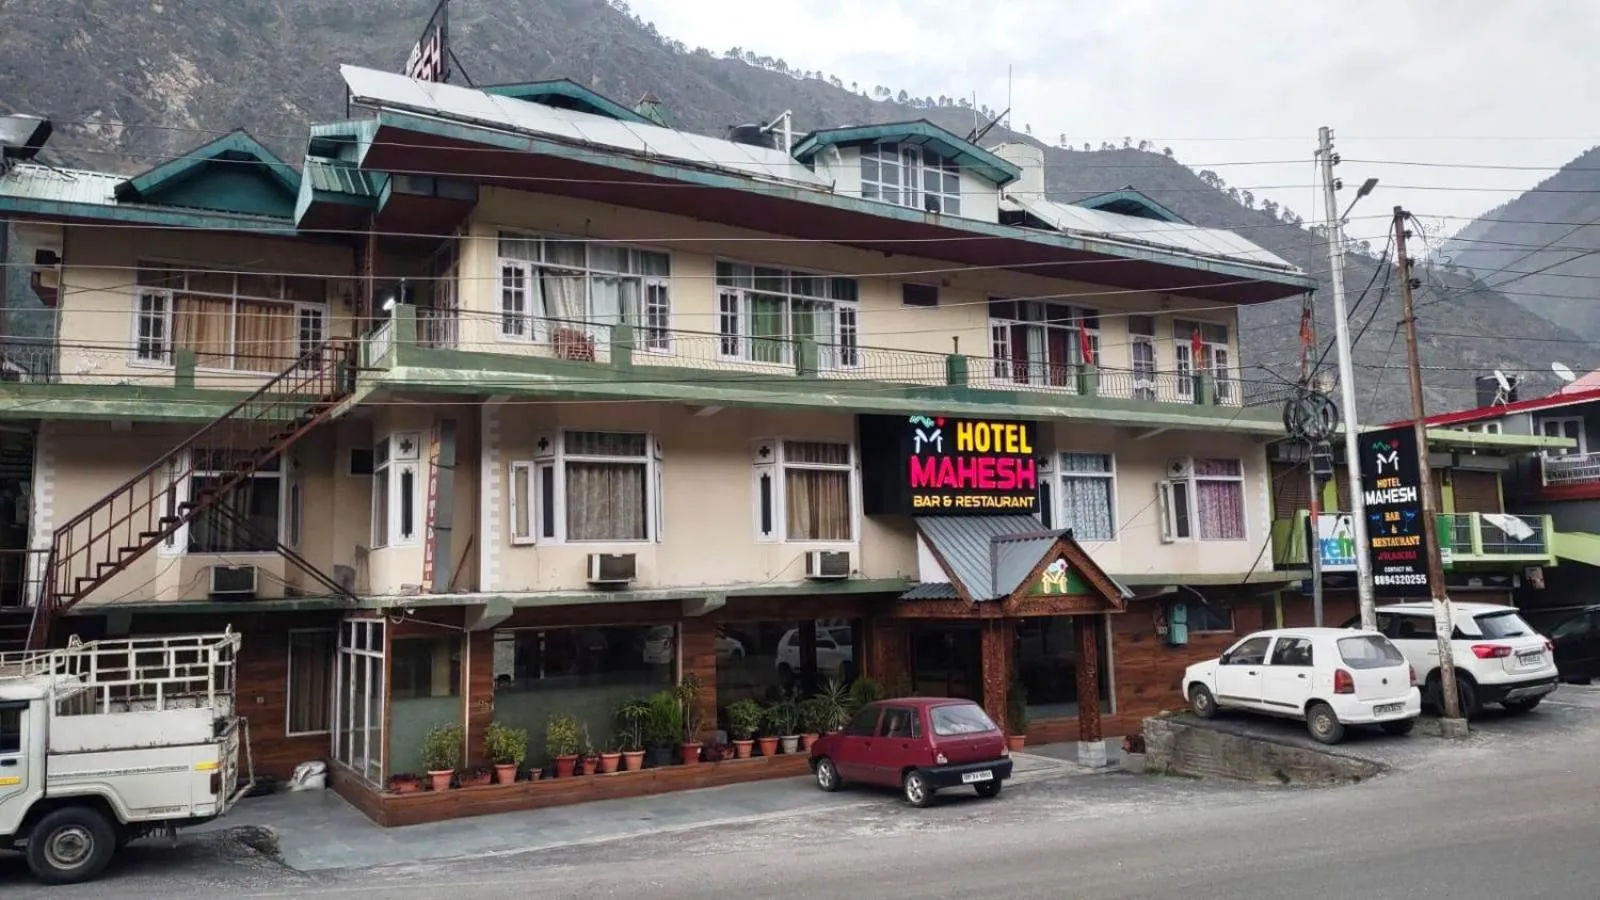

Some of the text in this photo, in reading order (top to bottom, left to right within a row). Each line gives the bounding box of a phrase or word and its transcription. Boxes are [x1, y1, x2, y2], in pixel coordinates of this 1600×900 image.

[956, 421, 1033, 454] HOTEL
[910, 455, 1036, 490] MAHESH
[1377, 477, 1401, 488] HOTEL
[913, 495, 1035, 508] BAR & RESTAURANT
[1365, 486, 1417, 506] MAHESH
[1384, 511, 1401, 522] BAR
[1372, 535, 1421, 548] RESTAURANT
